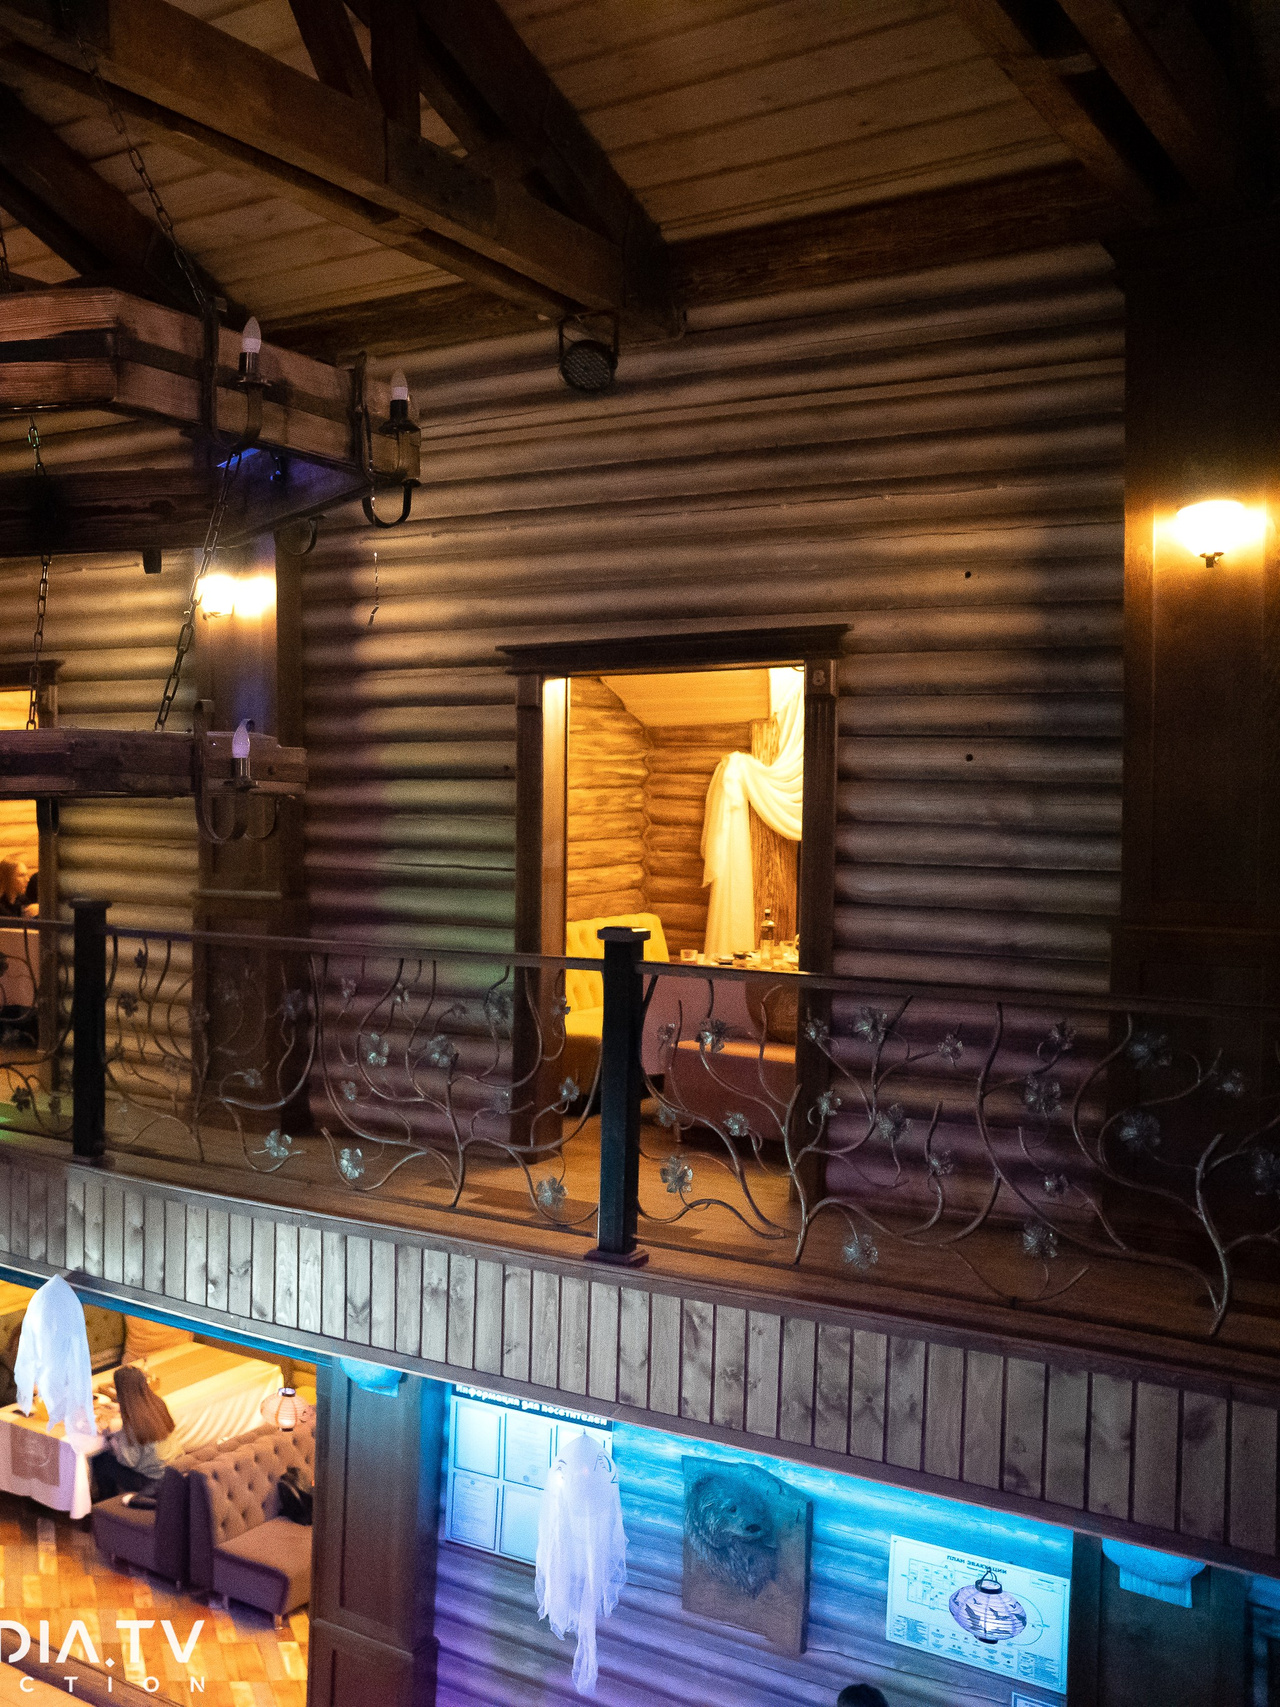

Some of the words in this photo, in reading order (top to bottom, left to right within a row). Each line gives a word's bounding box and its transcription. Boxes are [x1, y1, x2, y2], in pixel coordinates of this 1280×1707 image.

[455, 1383, 520, 1406] Информация
[521, 1400, 540, 1411] для
[946, 1555, 965, 1564] ПЛАН
[967, 1560, 1007, 1575] ЭВАКУЦИИ
